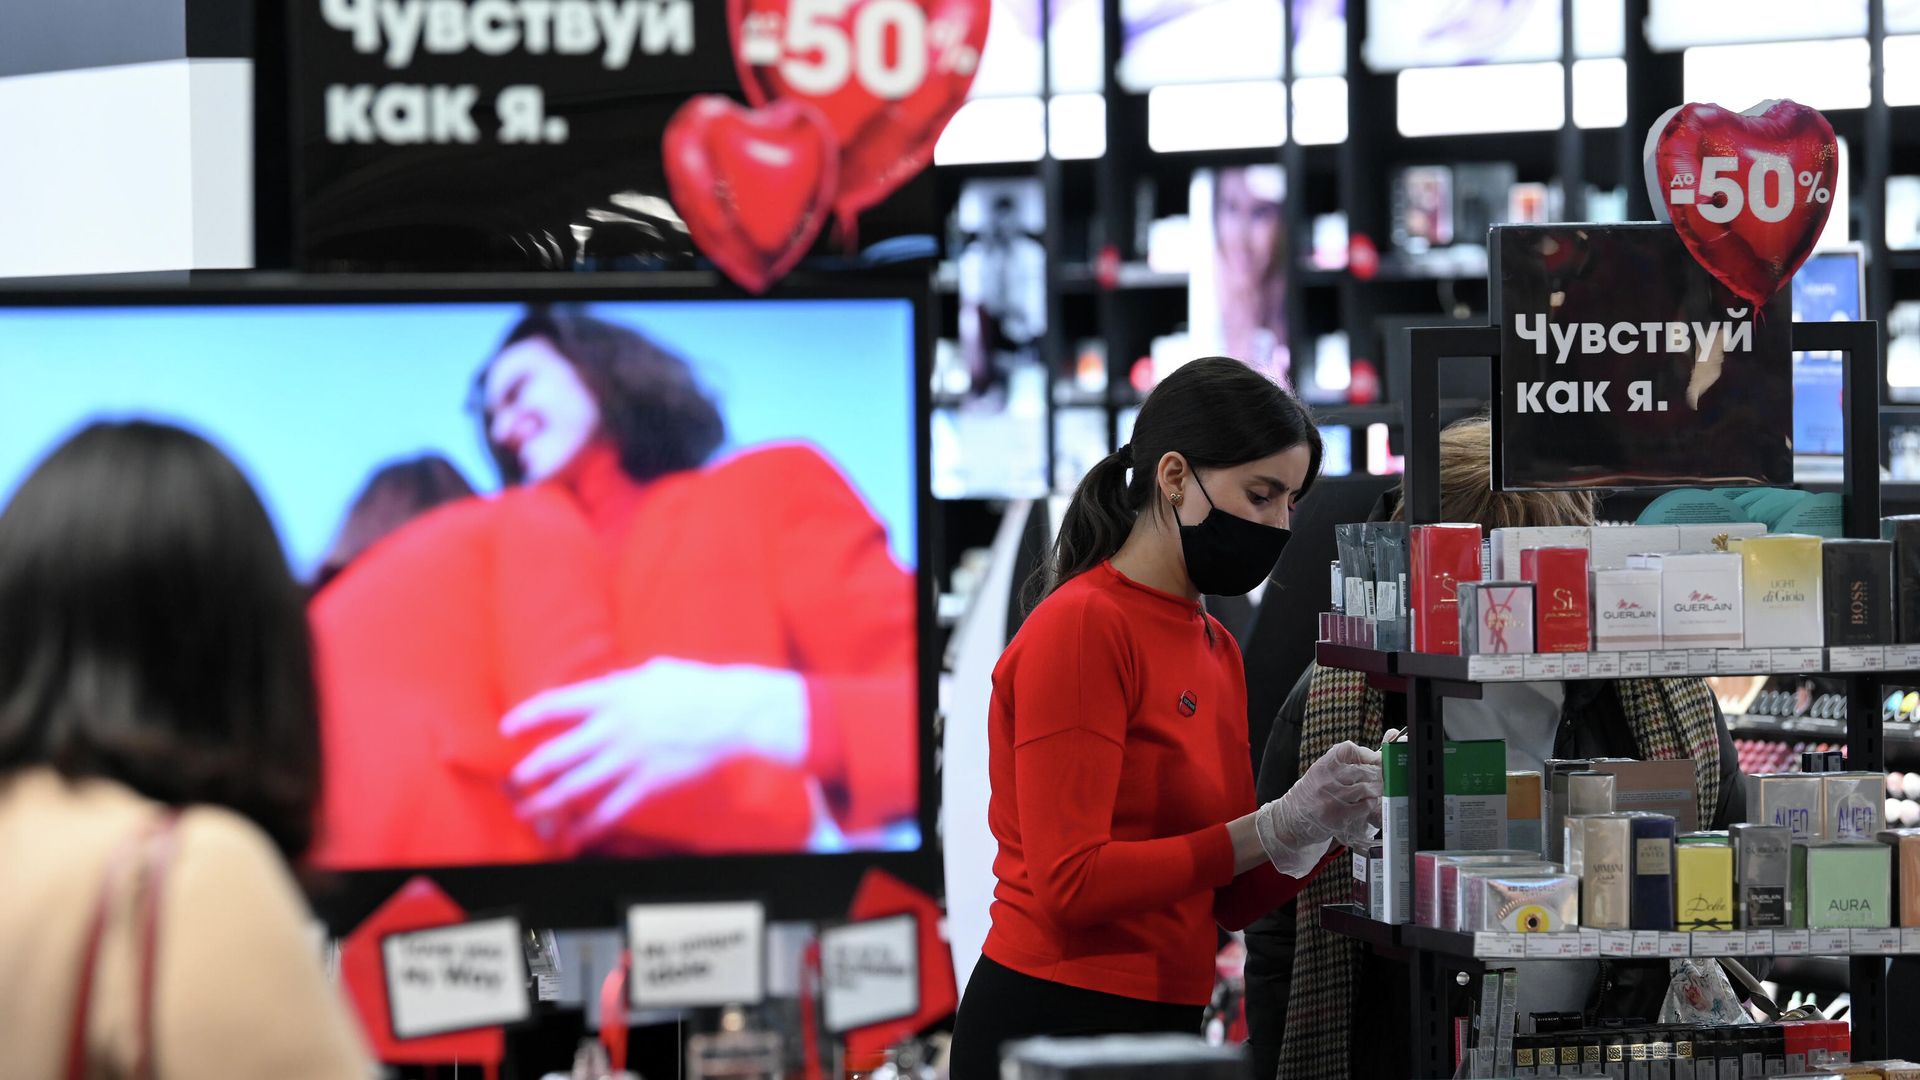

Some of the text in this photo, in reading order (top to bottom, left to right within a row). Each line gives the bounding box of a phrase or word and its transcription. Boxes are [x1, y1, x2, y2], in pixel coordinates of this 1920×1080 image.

[325, 83, 569, 144] как я.
[1515, 307, 1752, 364] Чувствуй
[1517, 380, 1668, 413] как я.
[1603, 610, 1656, 619] GUERLAIN
[1673, 602, 1732, 612] GUERLAIN
[1851, 580, 1864, 625] BOSS
[1684, 893, 1727, 917] Dolce
[1829, 899, 1871, 911] AURA
